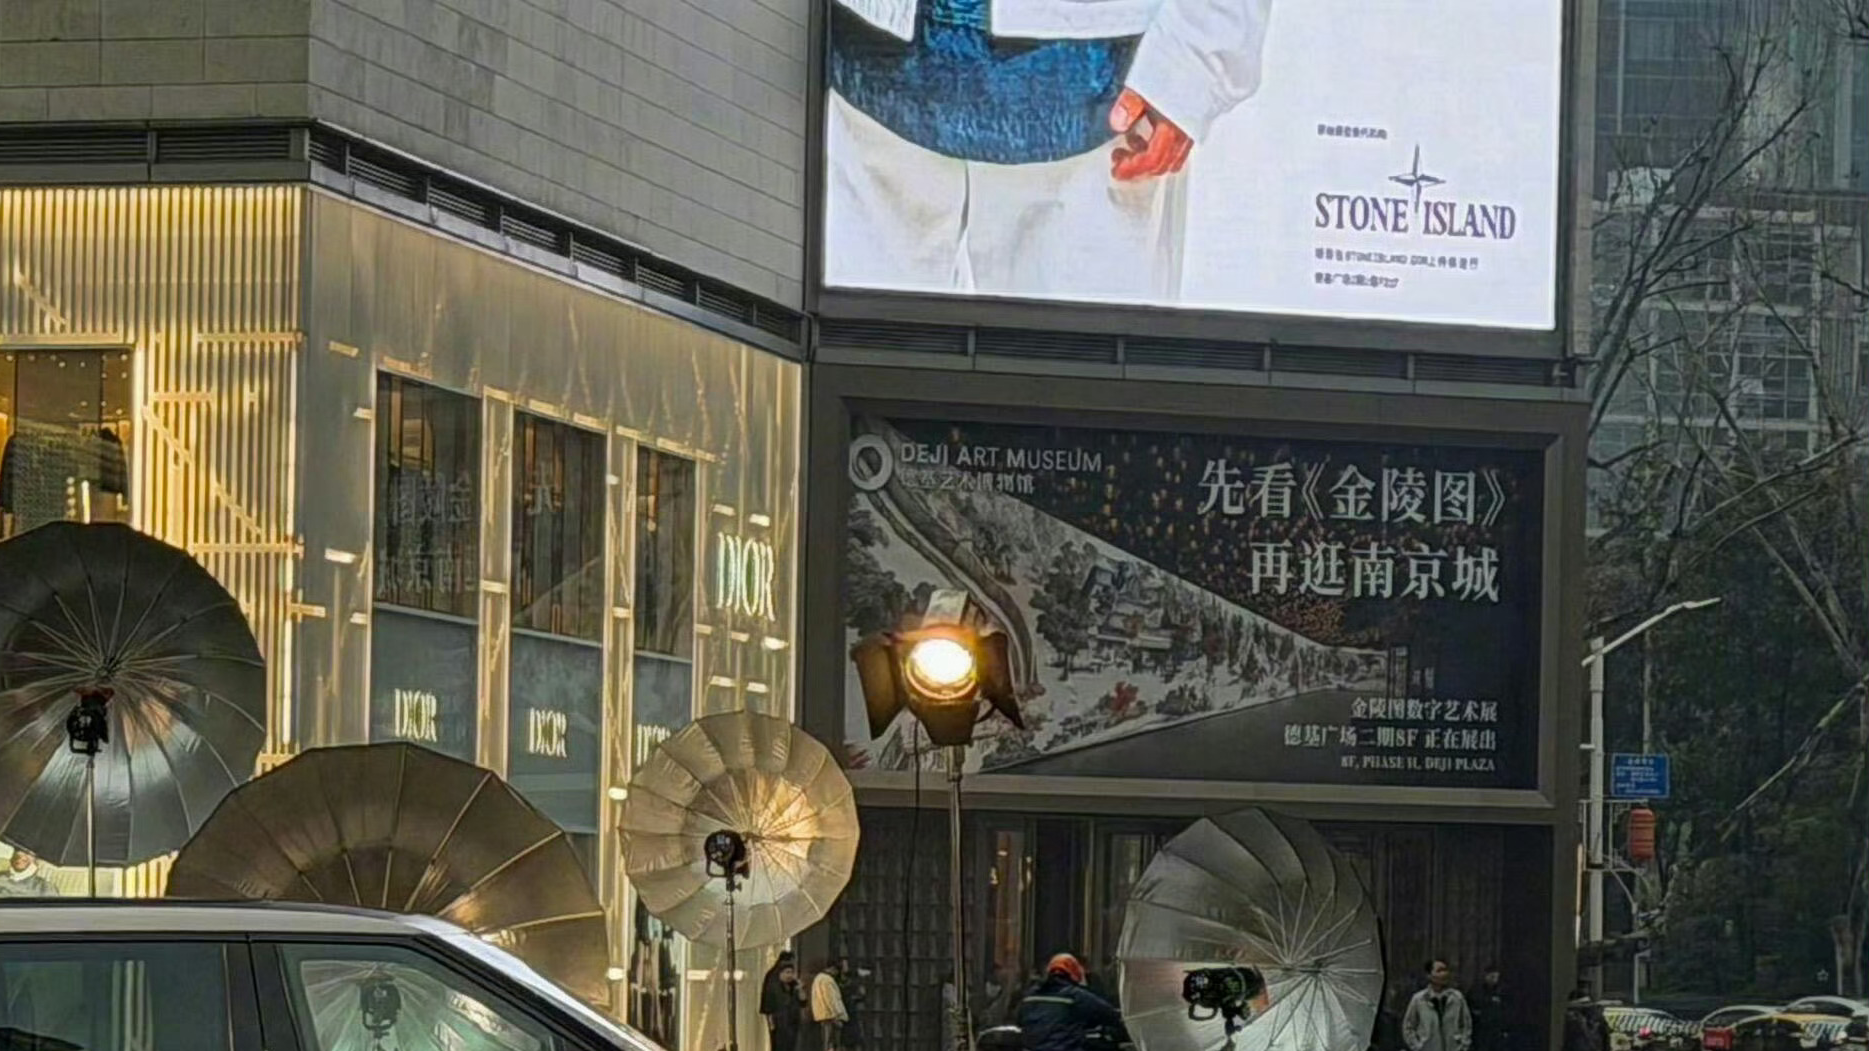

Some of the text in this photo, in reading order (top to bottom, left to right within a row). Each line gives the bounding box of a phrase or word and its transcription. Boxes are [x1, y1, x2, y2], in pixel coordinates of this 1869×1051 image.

[1316, 193, 1516, 239] STONE ISLAND
[900, 443, 1102, 472] DEJI ART MUSEUM
[1198, 458, 1506, 526] 先看《金陵图》
[716, 532, 775, 621] DIOR
[1247, 539, 1500, 602] 再逛南京城
[394, 688, 437, 743] DIOR
[529, 707, 567, 758] DIOR
[1351, 697, 1498, 722] 金陵图数字艺术展
[1455, 757, 1495, 771] PLAZA
